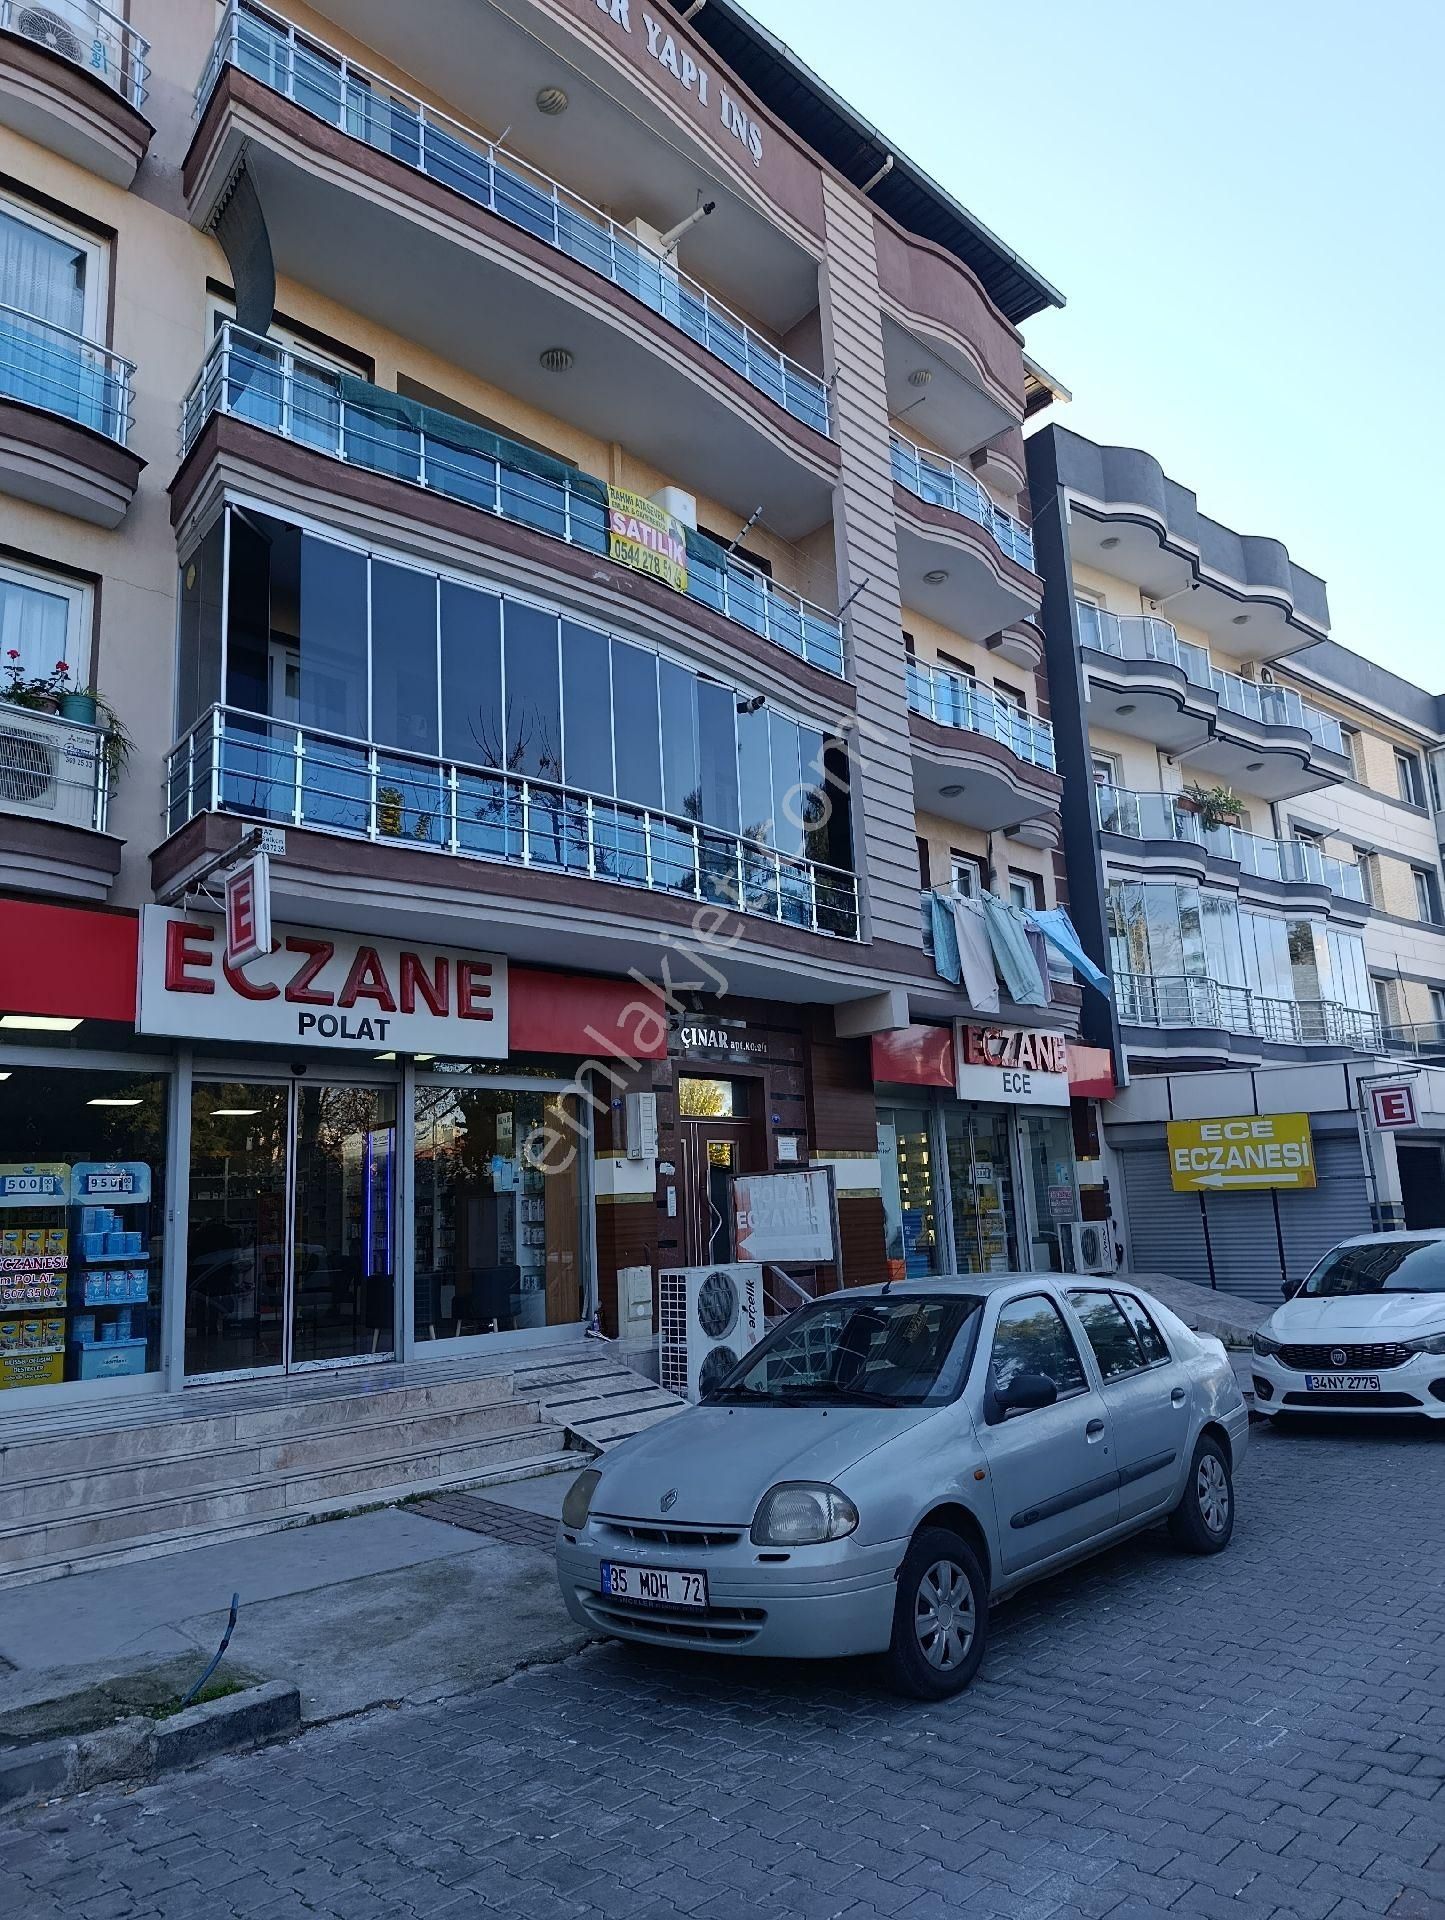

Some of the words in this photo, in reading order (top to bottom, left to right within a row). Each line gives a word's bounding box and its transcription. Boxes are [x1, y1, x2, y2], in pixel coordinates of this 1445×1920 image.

[643, 12, 708, 107] YAPI
[719, 84, 763, 167] İNŞ
[612, 512, 684, 567] SATILIK
[615, 539, 640, 566] 0544
[642, 550, 660, 574] 278
[232, 881, 253, 942] E
[165, 920, 494, 1020] ECZANE
[298, 1012, 391, 1042] POLAT
[680, 1027, 729, 1048] ÇINAR
[962, 1025, 1067, 1073] ECZANE
[1002, 1072, 1032, 1094] ECE
[1380, 1093, 1406, 1120] E
[1200, 1120, 1275, 1141] ECE
[1175, 1136, 1310, 1172] ECZANESİ
[7, 1179, 37, 1189] 500
[4, 1288, 25, 1299] 507
[15, 1273, 54, 1285] POLAT
[1312, 1377, 1327, 1389] 34
[1328, 1377, 1345, 1389] NY
[1347, 1377, 1378, 1390] 2775
[610, 1567, 628, 1592] 35
[682, 1576, 703, 1602] 72
